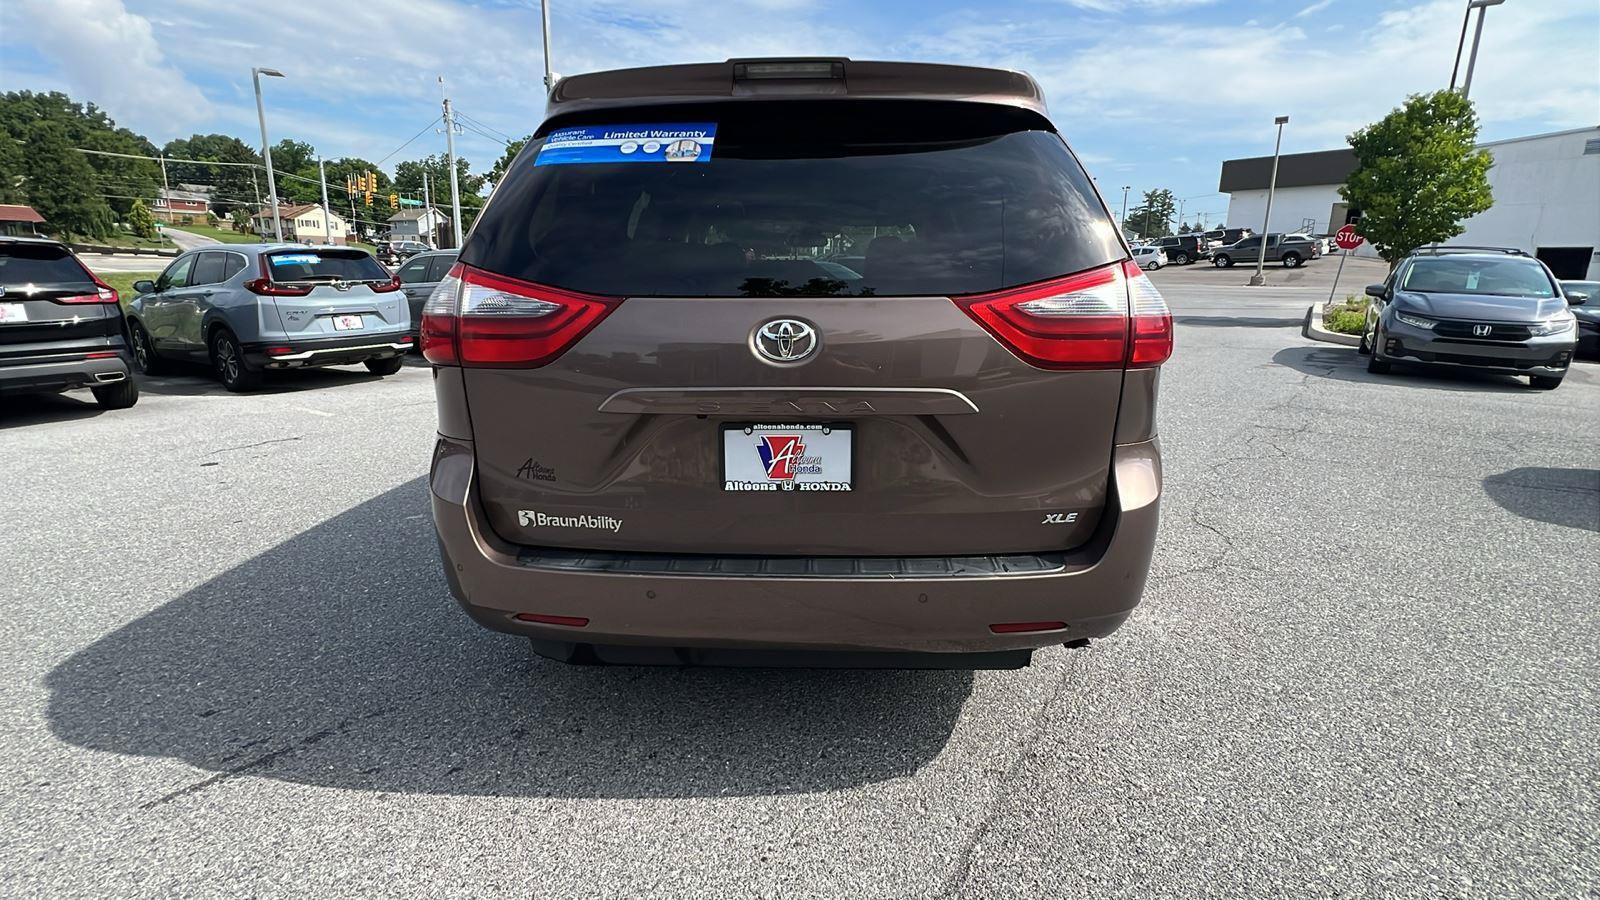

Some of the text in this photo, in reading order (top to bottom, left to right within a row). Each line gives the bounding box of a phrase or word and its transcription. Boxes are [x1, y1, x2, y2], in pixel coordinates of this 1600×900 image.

[603, 130, 707, 139] Limited Warranty
[1336, 231, 1364, 243] STOP
[789, 464, 822, 474] Honda
[724, 481, 777, 491] Altoona
[799, 482, 852, 491] HONDA
[537, 512, 622, 533] BraunAbility
[1041, 512, 1079, 524] XLE
